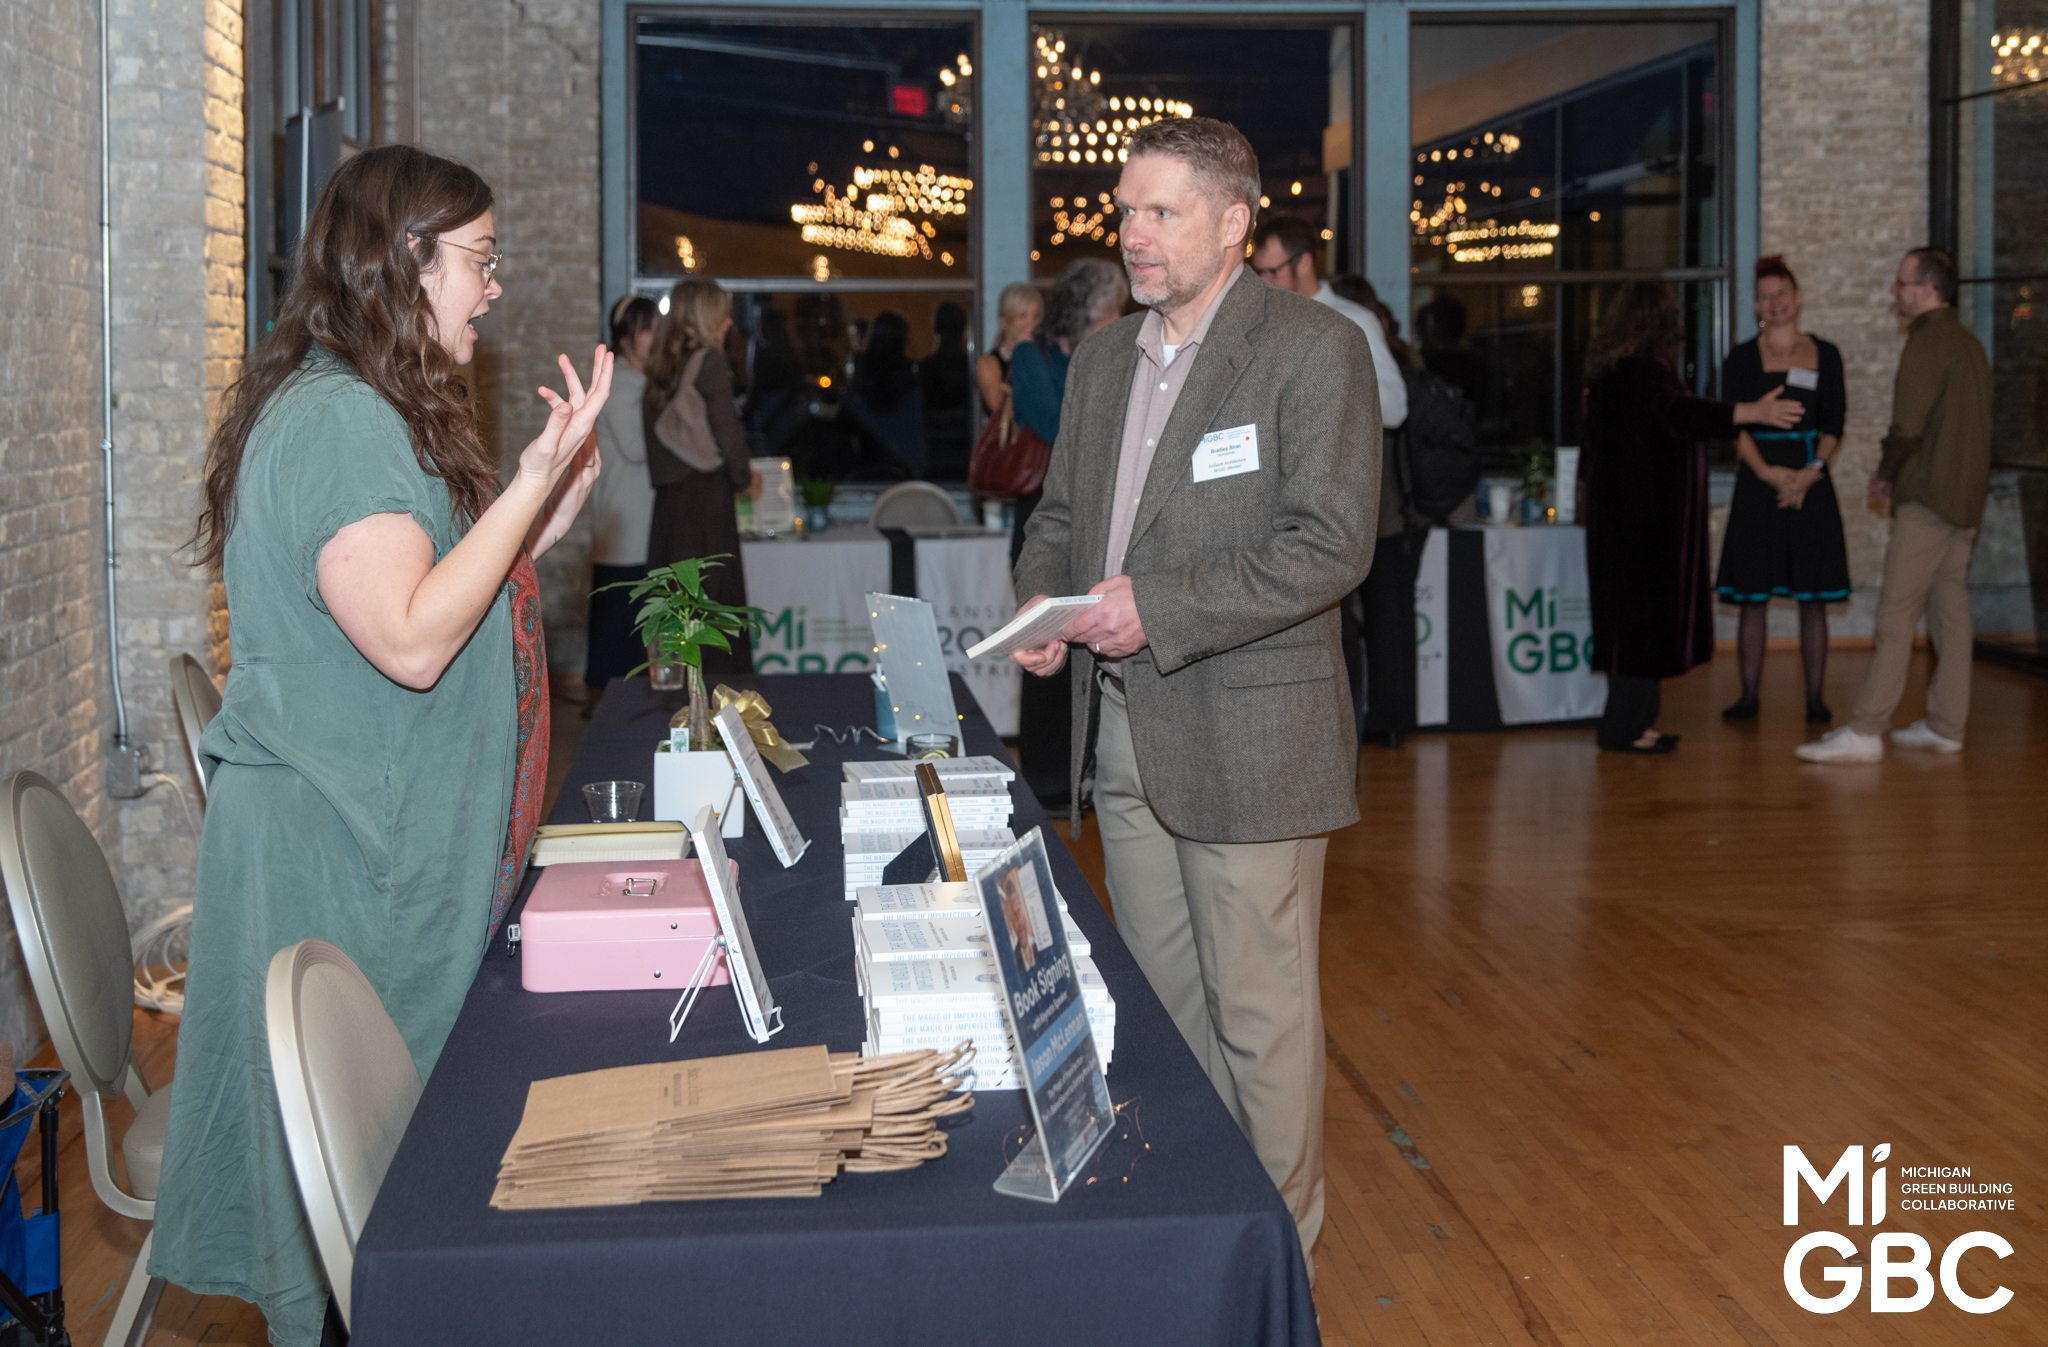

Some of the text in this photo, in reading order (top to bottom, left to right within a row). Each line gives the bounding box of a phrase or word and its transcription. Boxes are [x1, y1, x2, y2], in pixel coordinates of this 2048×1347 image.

[1507, 631, 1593, 674] GB
[927, 911, 971, 919] IMPERFECTION
[941, 951, 988, 959] IMPERFECTION
[1013, 953, 1070, 1019] Book Signing
[935, 996, 944, 1004] OF
[946, 995, 996, 1003] IMPERFECTION
[902, 1014, 914, 1022] THE
[918, 1013, 940, 1021] MAGIC
[954, 1010, 1003, 1019] IMPERFECTION
[919, 1024, 942, 1032] MAGIC
[955, 1021, 1005, 1030] IMPERFECTION
[917, 1036, 940, 1044] MAGIC
[942, 1035, 950, 1043] OF
[1030, 1046, 1054, 1079] Jason
[1049, 1012, 1086, 1058] McLennan
